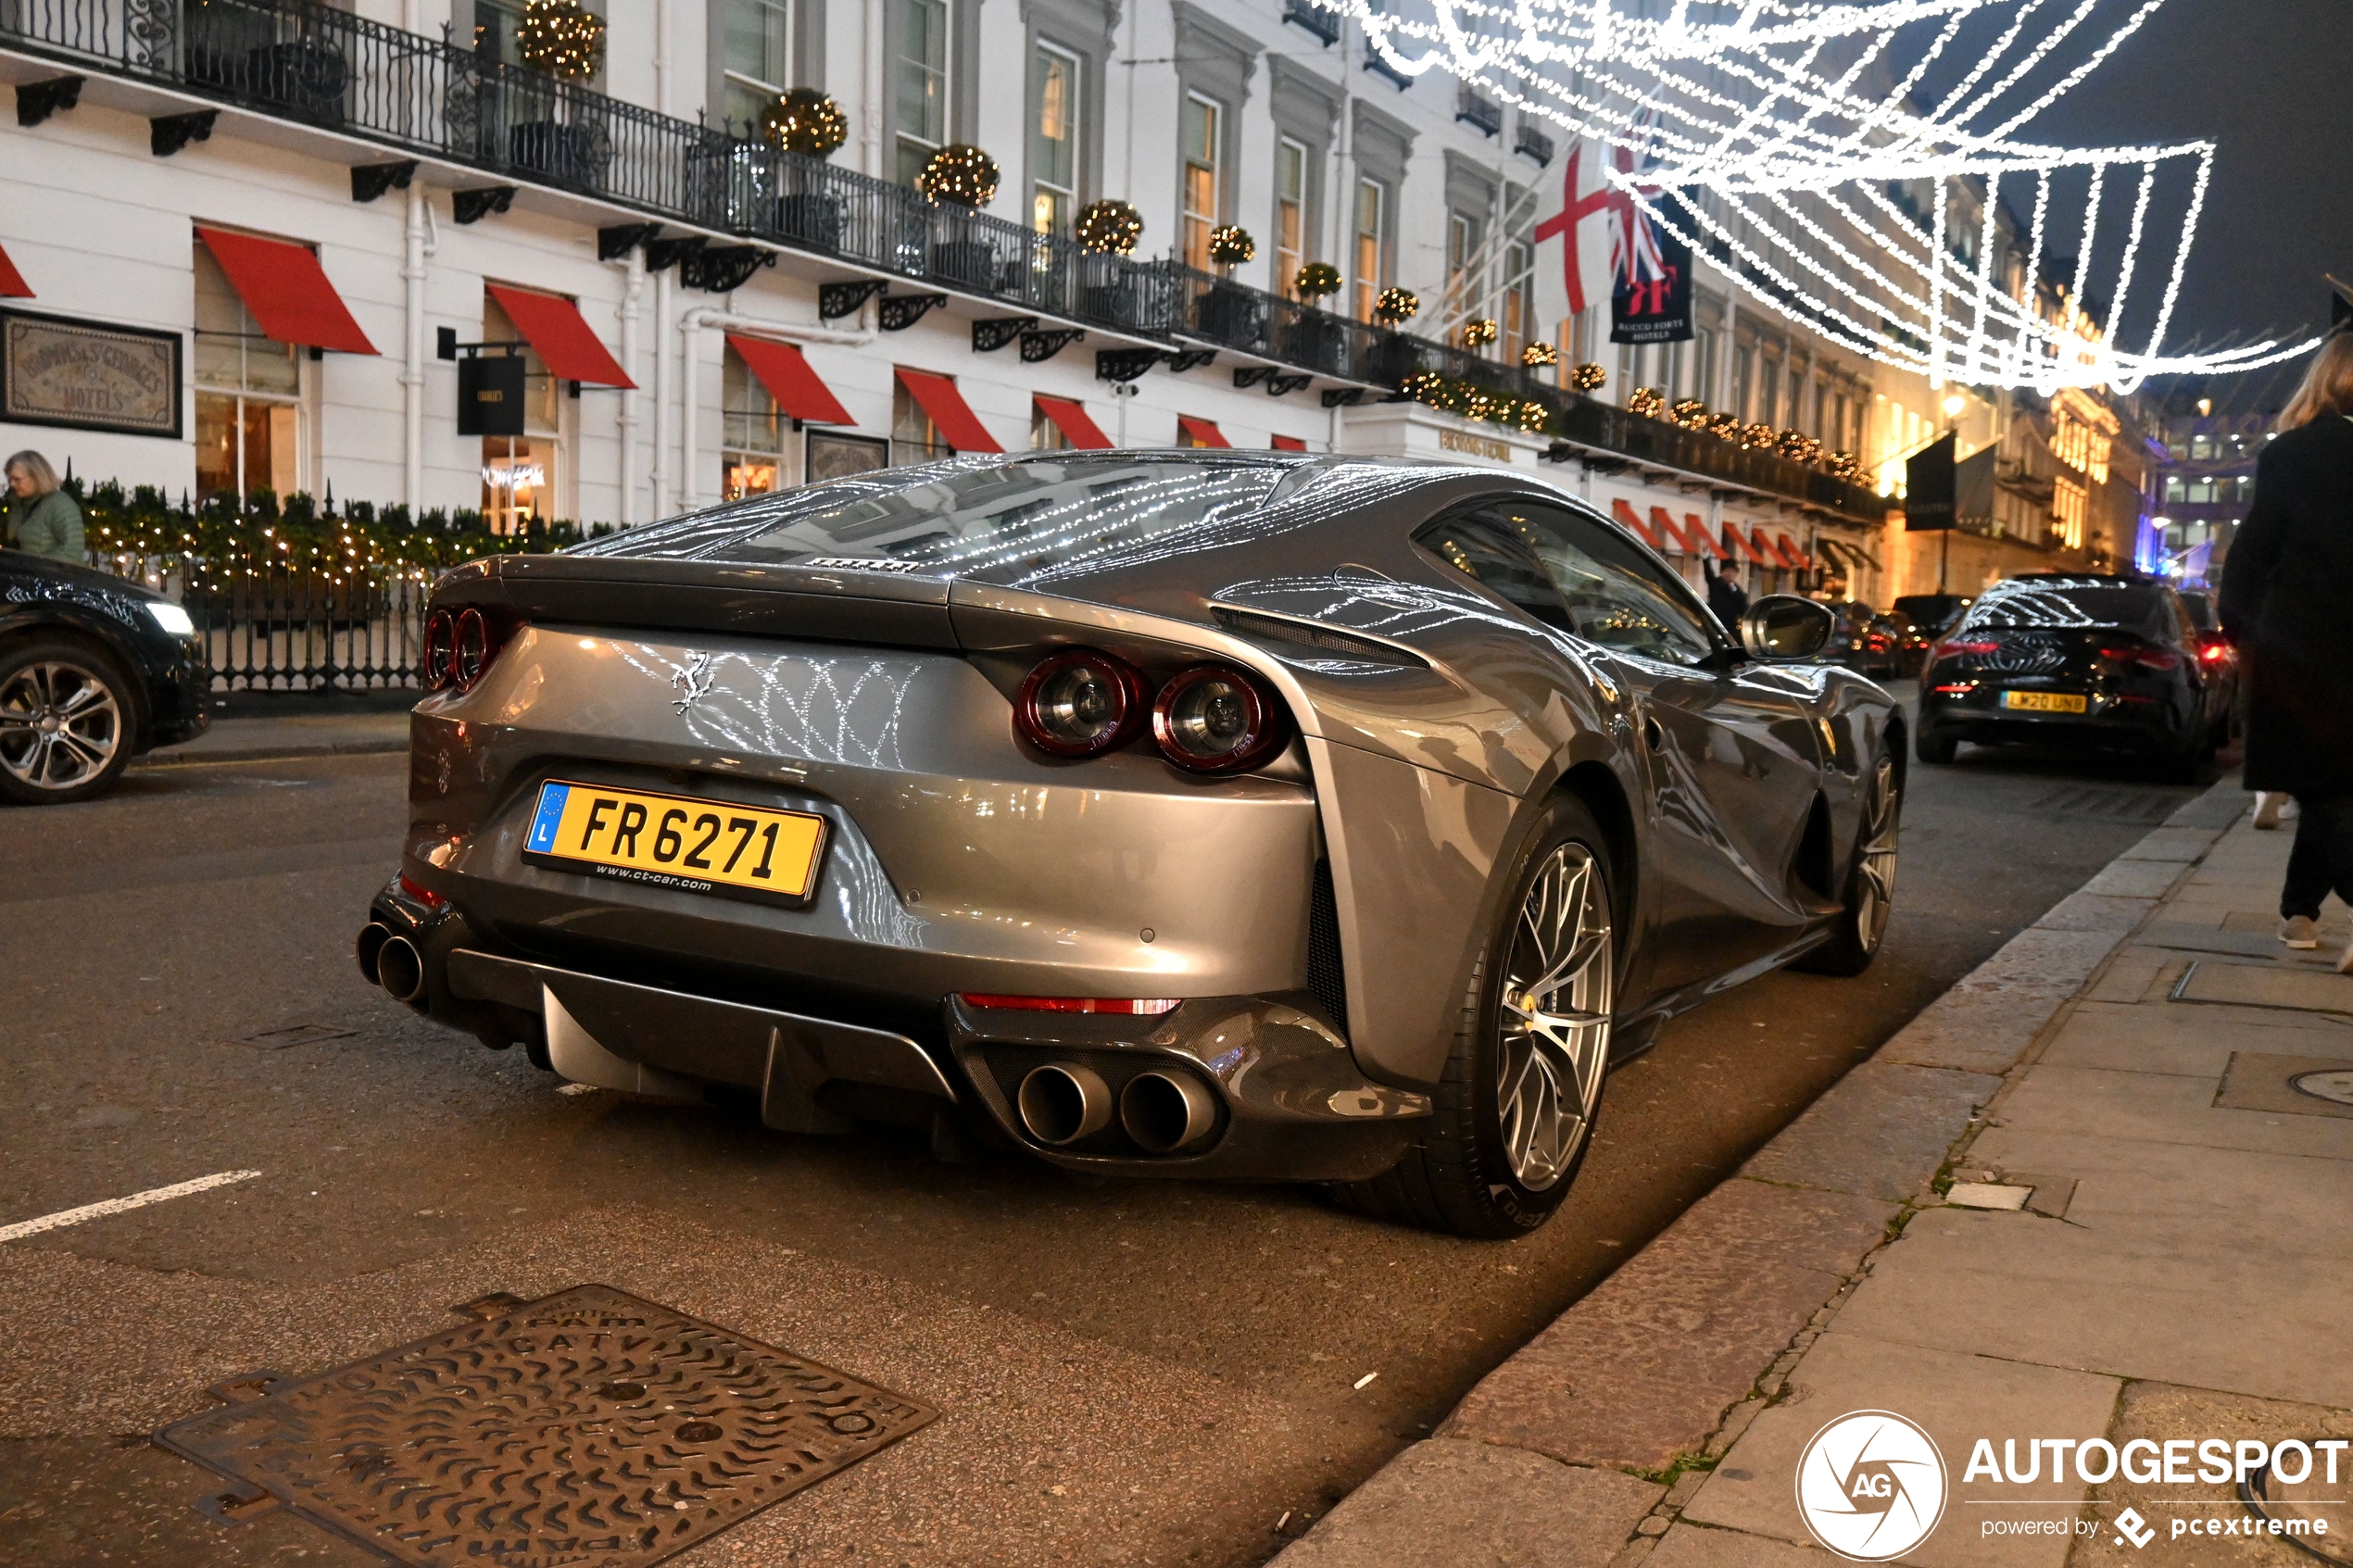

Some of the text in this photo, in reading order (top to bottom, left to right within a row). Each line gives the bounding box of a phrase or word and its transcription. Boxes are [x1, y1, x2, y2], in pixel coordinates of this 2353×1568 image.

[1654, 319, 1684, 330] FORTE
[1632, 331, 1670, 341] HOTELS
[63, 386, 123, 411] HOTELS
[538, 823, 547, 843] L
[597, 865, 712, 892] www.ct-car.com
[510, 1333, 652, 1354] CATV
